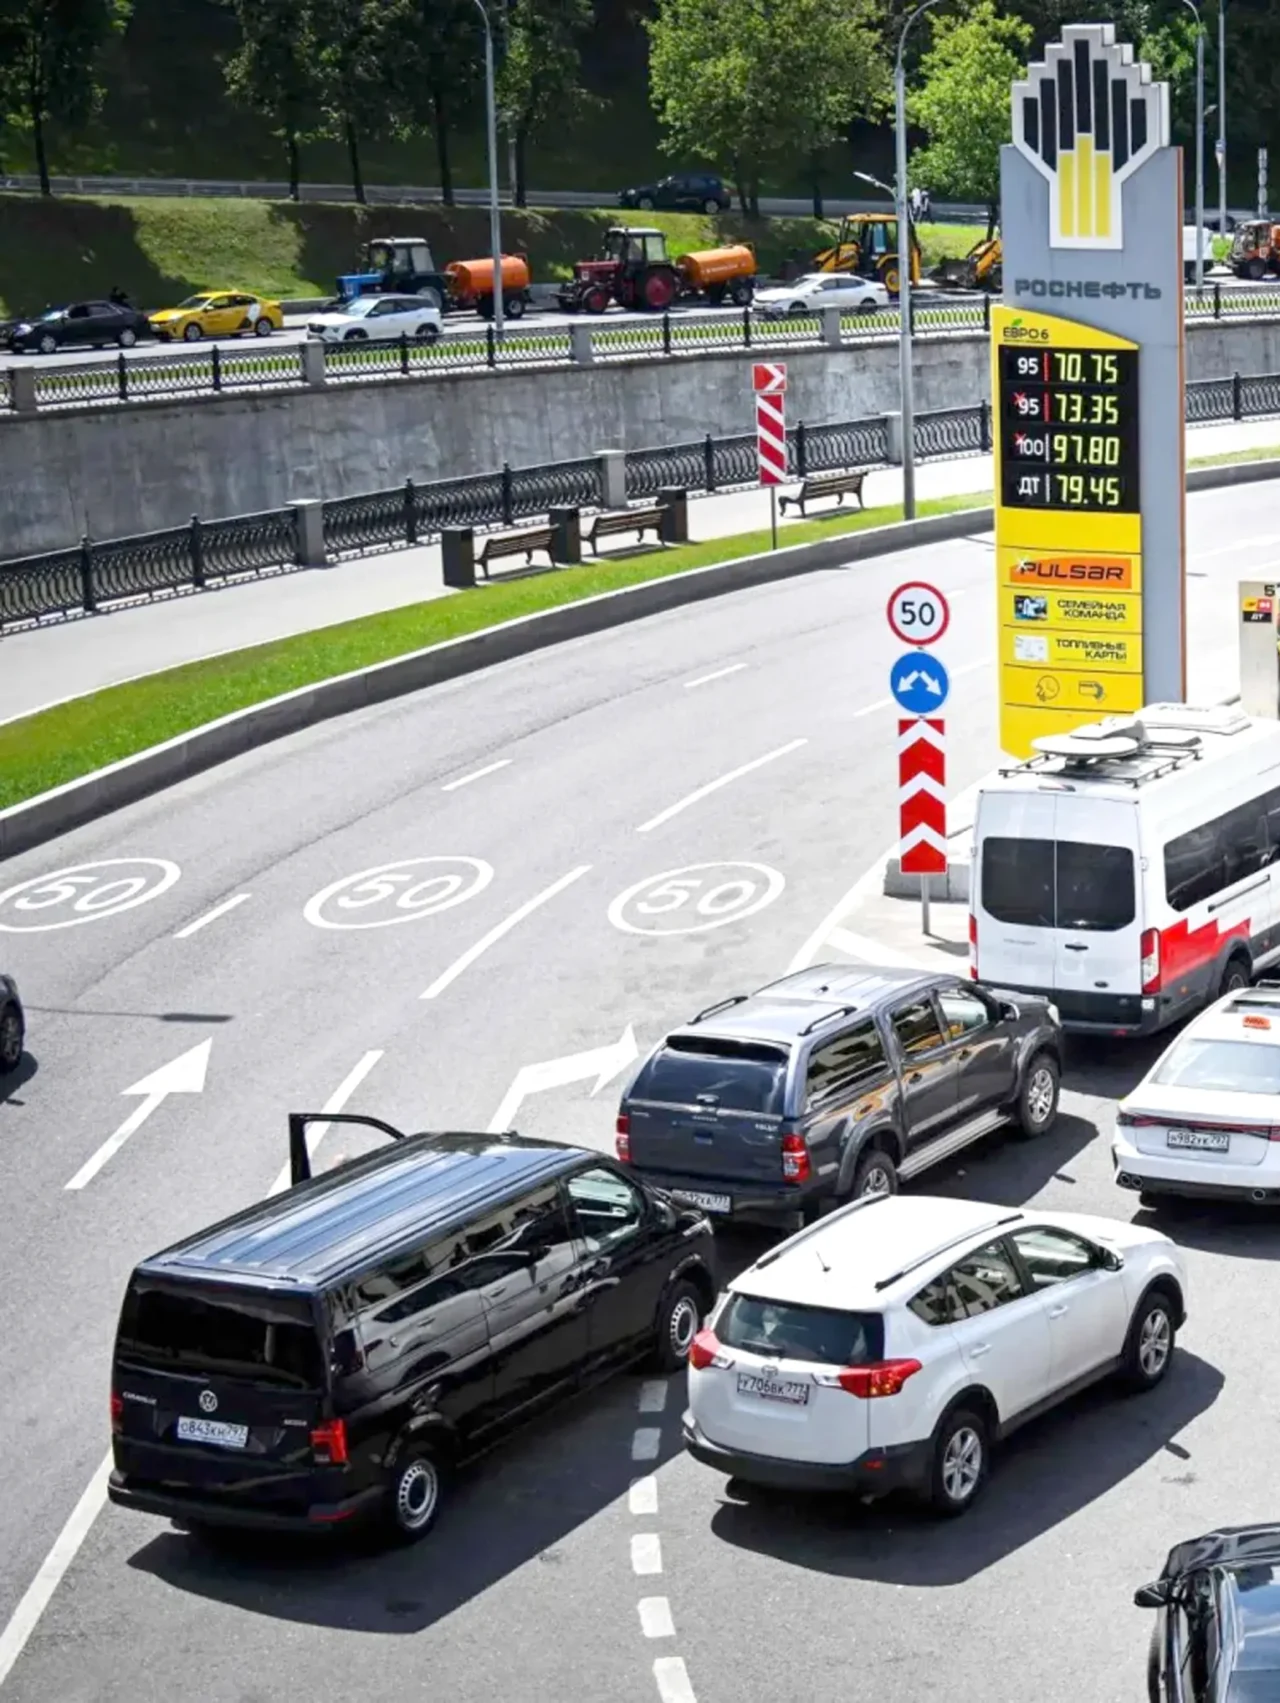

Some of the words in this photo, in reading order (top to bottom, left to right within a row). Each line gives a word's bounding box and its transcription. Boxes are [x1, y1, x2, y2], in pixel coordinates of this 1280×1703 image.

[1014, 279, 1162, 300] РОСНЕФТЬ
[1003, 326, 1040, 340] ЕВРО
[1041, 328, 1049, 341] 6
[1017, 357, 1039, 375] 95
[1054, 352, 1118, 384] 70.75
[1018, 397, 1040, 416] 95
[1054, 393, 1119, 424] 73.35
[1016, 437, 1044, 456] 100
[1053, 434, 1120, 466] 97.80
[1017, 476, 1040, 495] ДТ
[1056, 475, 1119, 506] 79.45
[1263, 584, 1276, 598] 5
[901, 601, 936, 626] 50
[1057, 599, 1127, 612] СЕМЕЙНАЯ
[1064, 609, 1126, 621] КОМАНДА
[1056, 638, 1127, 651] ТОПЛИВНЫЕ
[1085, 650, 1128, 660] КАРТЫ
[14, 876, 147, 911] 50
[336, 874, 465, 911] 50
[637, 880, 758, 916] 50
